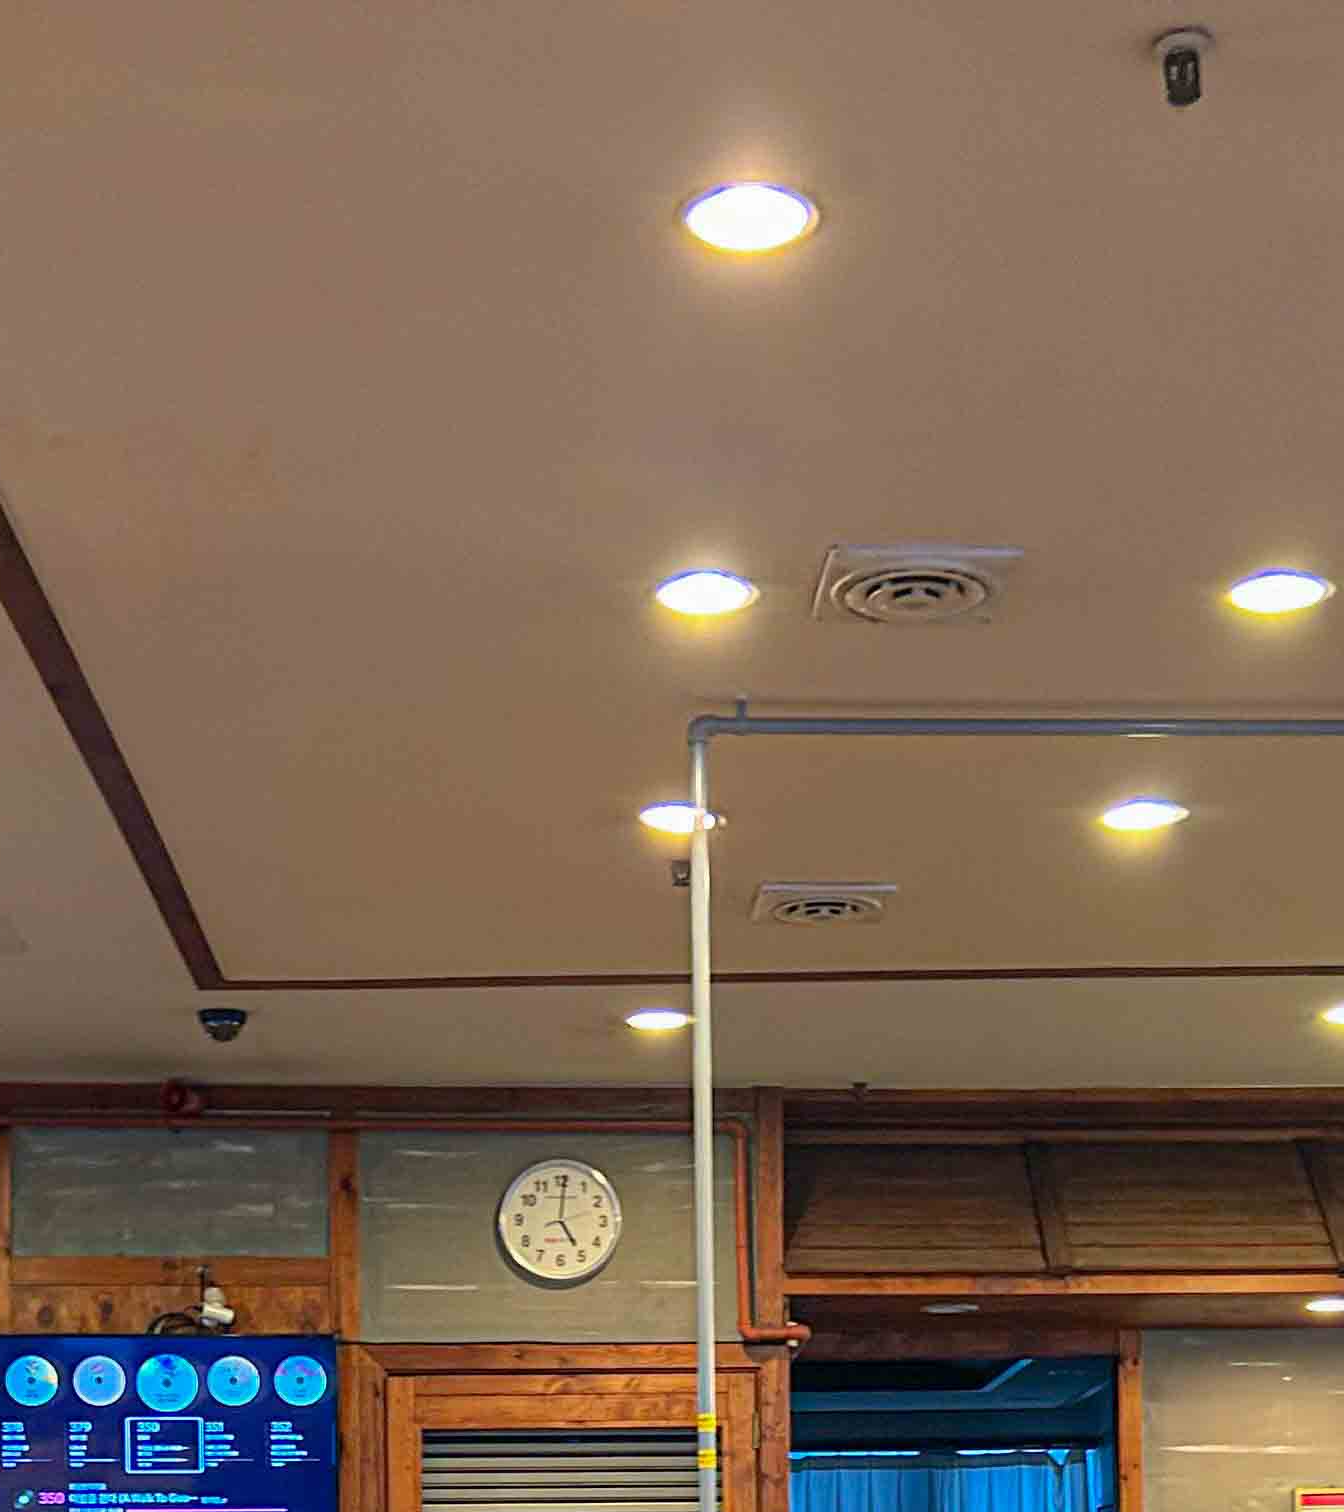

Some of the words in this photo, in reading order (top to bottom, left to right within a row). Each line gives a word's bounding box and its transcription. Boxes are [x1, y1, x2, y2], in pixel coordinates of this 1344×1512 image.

[533, 1180, 547, 1192] 11
[520, 1193, 536, 1206] 10
[592, 1195, 602, 1207] 2
[513, 1213, 523, 1226] 9
[599, 1215, 608, 1227] 3
[521, 1234, 530, 1247] 8
[591, 1236, 601, 1246] 4
[535, 1249, 544, 1261] 7
[556, 1254, 566, 1266] 6
[576, 1250, 586, 1262] 5
[38, 1491, 65, 1505] 350
